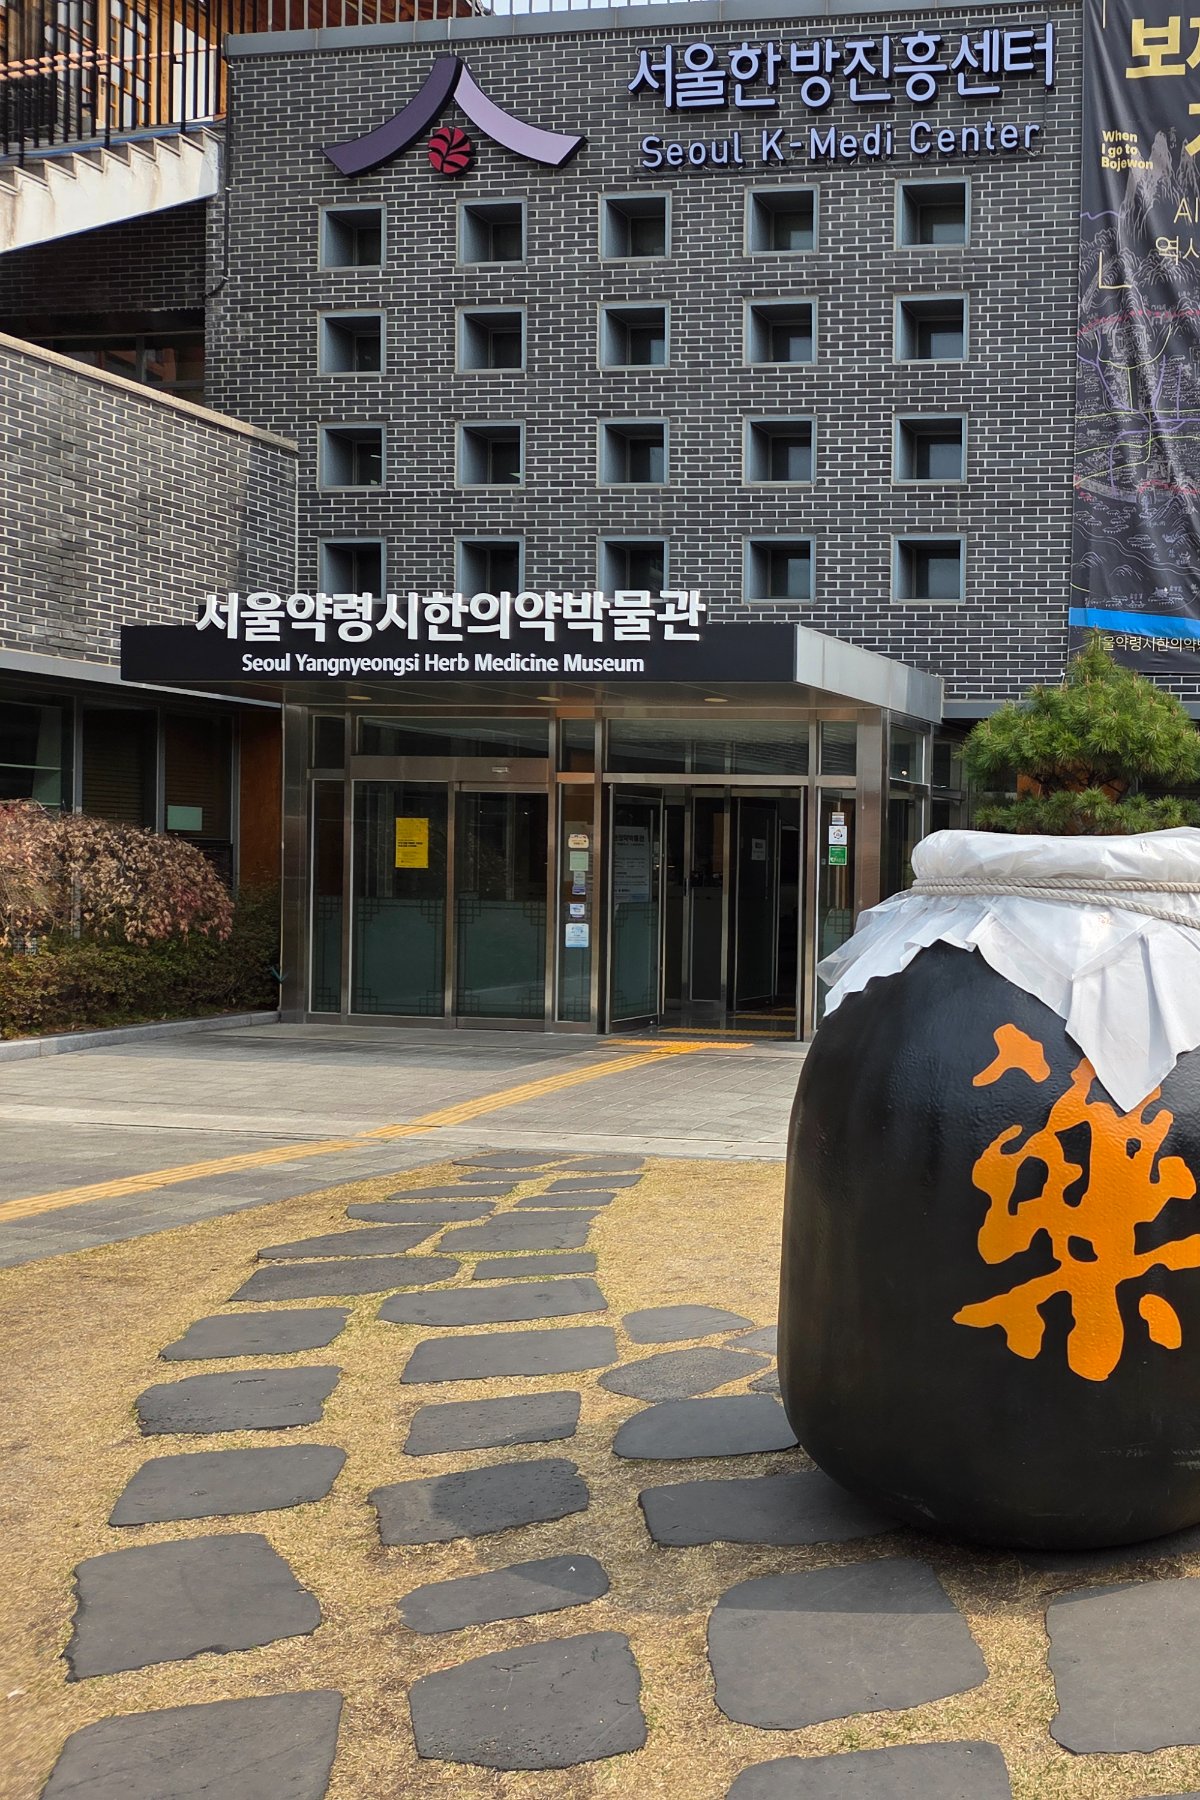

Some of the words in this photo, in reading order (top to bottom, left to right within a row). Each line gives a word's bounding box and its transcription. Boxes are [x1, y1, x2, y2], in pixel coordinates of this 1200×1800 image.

[628, 22, 1055, 110] 서울한방진흥센터
[641, 131, 744, 168] Seoul
[762, 124, 893, 162] K-Medi
[909, 120, 1041, 154] Center
[1102, 130, 1138, 143] When
[1101, 143, 1106, 154] I
[1107, 147, 1123, 158] go
[1125, 144, 1138, 155] to
[1101, 156, 1154, 172] Bojewon
[195, 590, 706, 643] 서울약령시한의약박물관
[242, 653, 291, 673] Seoul
[295, 653, 420, 677] Yangnyeongsi
[425, 653, 470, 673] Herb
[474, 653, 559, 673] Medicine
[563, 653, 645, 673] Museum
